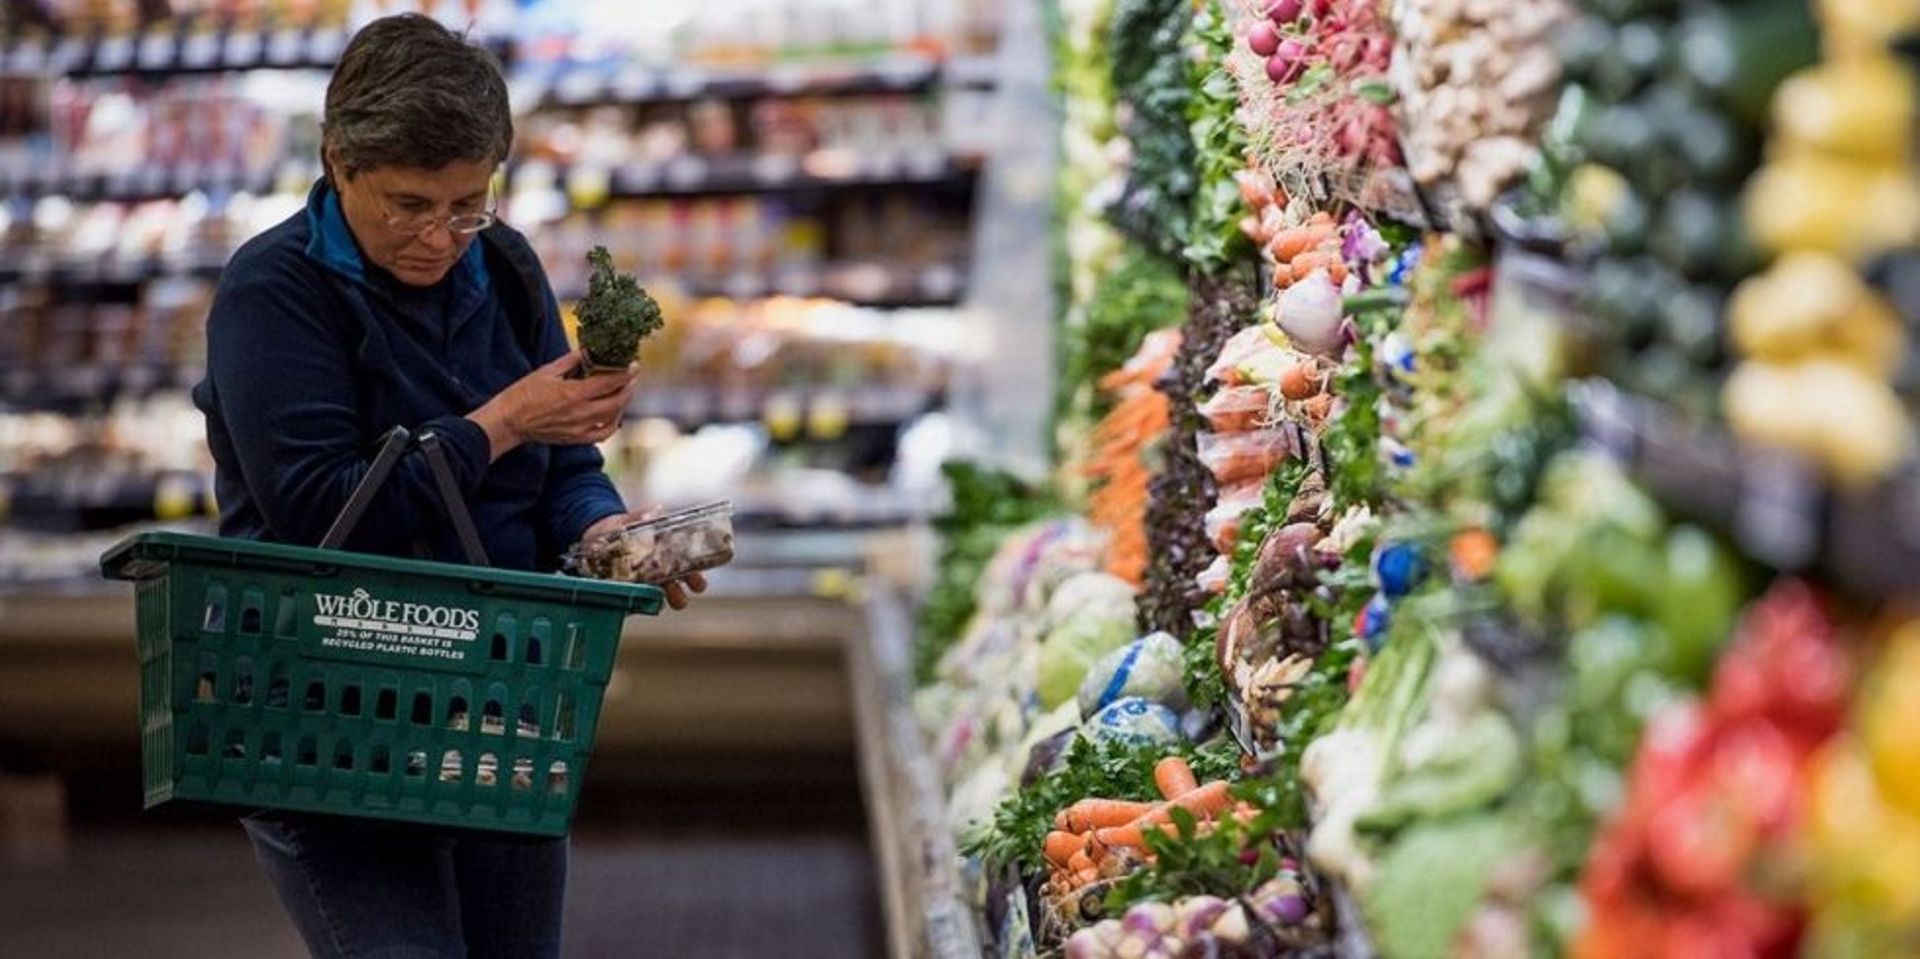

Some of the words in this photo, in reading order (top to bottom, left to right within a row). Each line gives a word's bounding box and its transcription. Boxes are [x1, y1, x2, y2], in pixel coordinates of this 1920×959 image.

[314, 591, 400, 622] WHOLE
[404, 603, 479, 630] FOODS
[322, 637, 375, 650] RECYCLED
[376, 643, 418, 654] PLASTIC
[419, 647, 465, 660] BOTTLES
[336, 629, 357, 638] 25%
[359, 630, 373, 639] OF
[375, 633, 398, 642] THIS
[400, 636, 440, 646] BASKET
